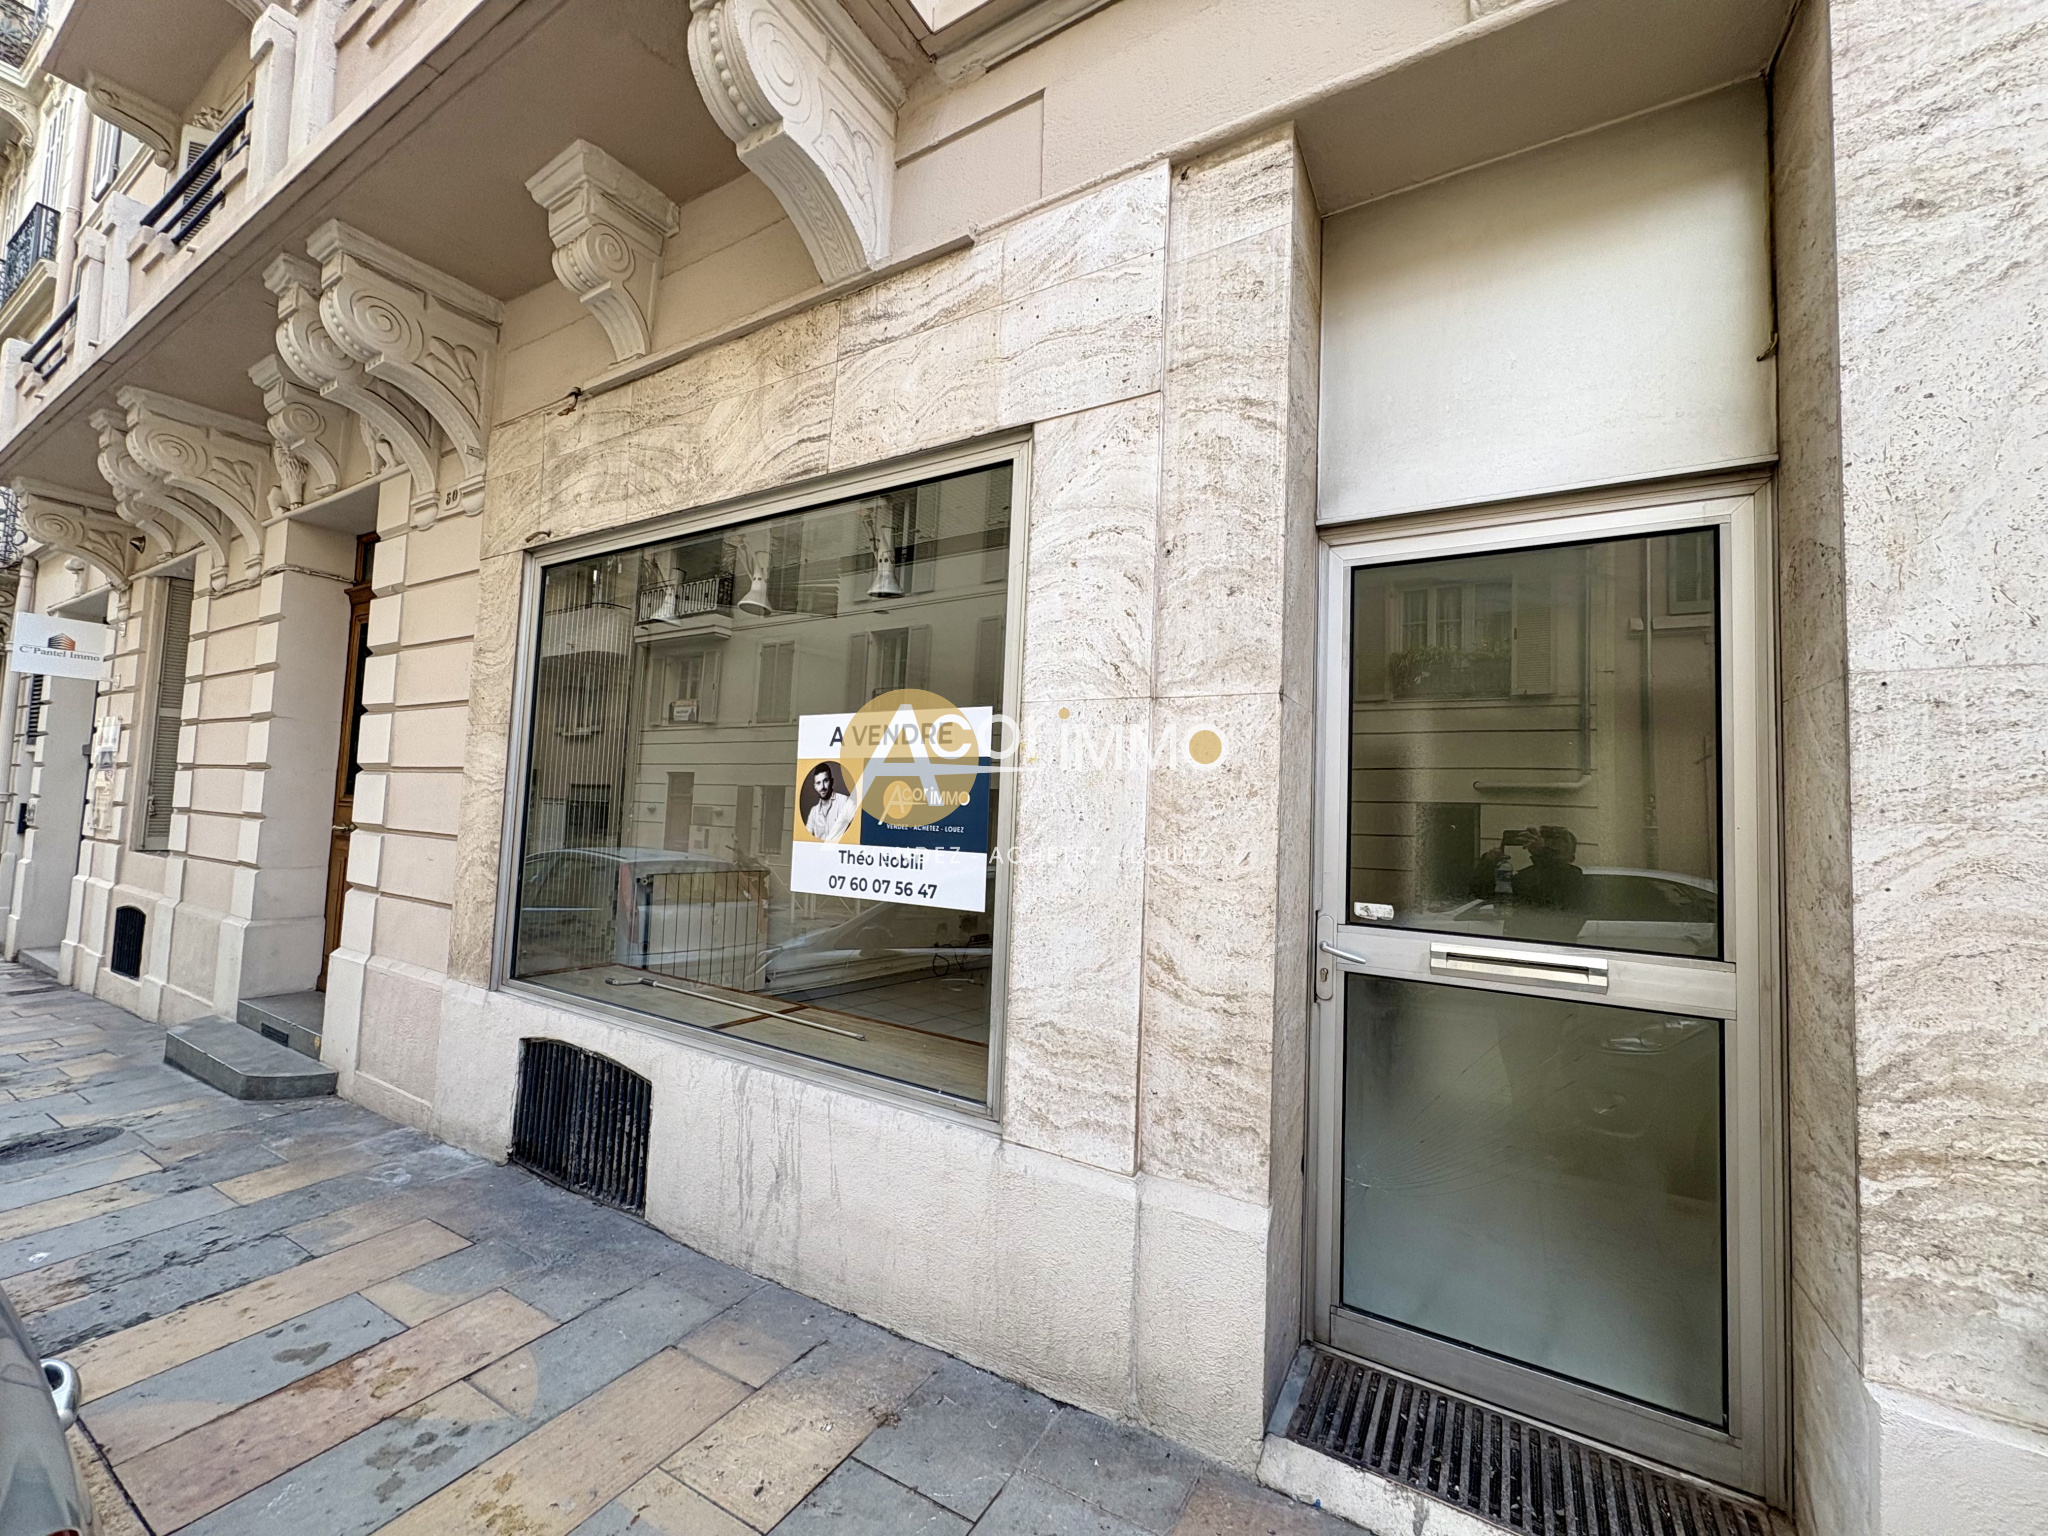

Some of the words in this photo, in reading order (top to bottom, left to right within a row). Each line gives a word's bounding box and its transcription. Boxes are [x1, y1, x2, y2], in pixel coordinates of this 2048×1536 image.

[446, 489, 458, 505] 50
[70, 652, 100, 661] Immo
[829, 726, 845, 747] A
[852, 722, 954, 746] VENDRE
[913, 824, 939, 832] ACHETEZ
[838, 850, 874, 866] Théo
[879, 853, 924, 870] Nobili
[828, 875, 846, 889] 07
[850, 877, 868, 892] 60
[872, 878, 891, 894] 07
[894, 880, 913, 897] 56
[917, 883, 938, 899] 47
